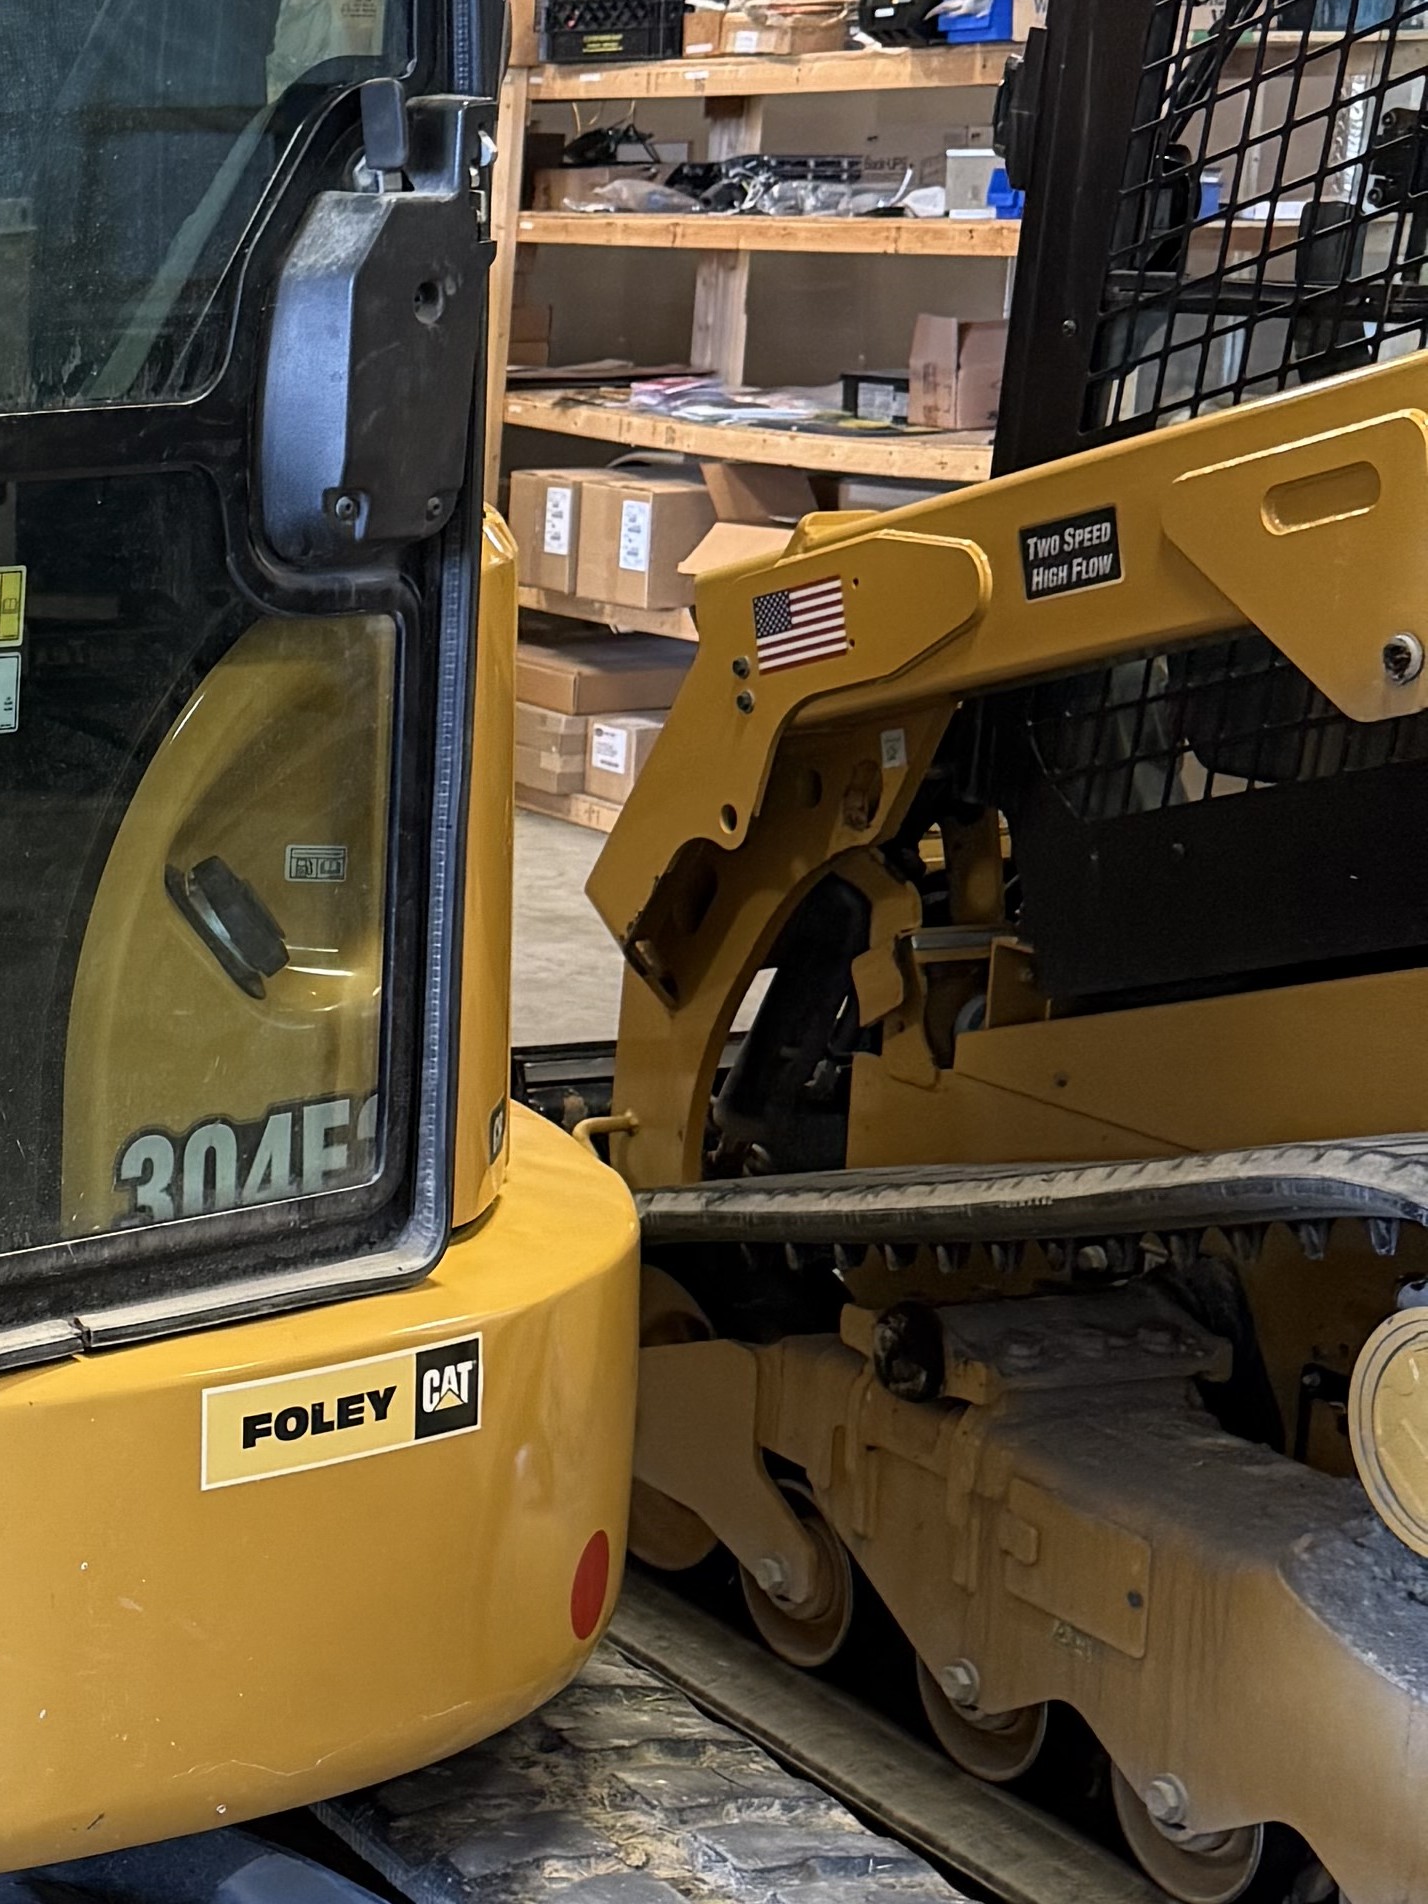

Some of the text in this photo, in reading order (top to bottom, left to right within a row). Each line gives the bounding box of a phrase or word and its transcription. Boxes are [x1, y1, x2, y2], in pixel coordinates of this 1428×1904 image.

[1063, 521, 1111, 552] SPEED
[1031, 553, 1113, 592] HIGH FLOW
[242, 1360, 474, 1449] FOLEY CAT
